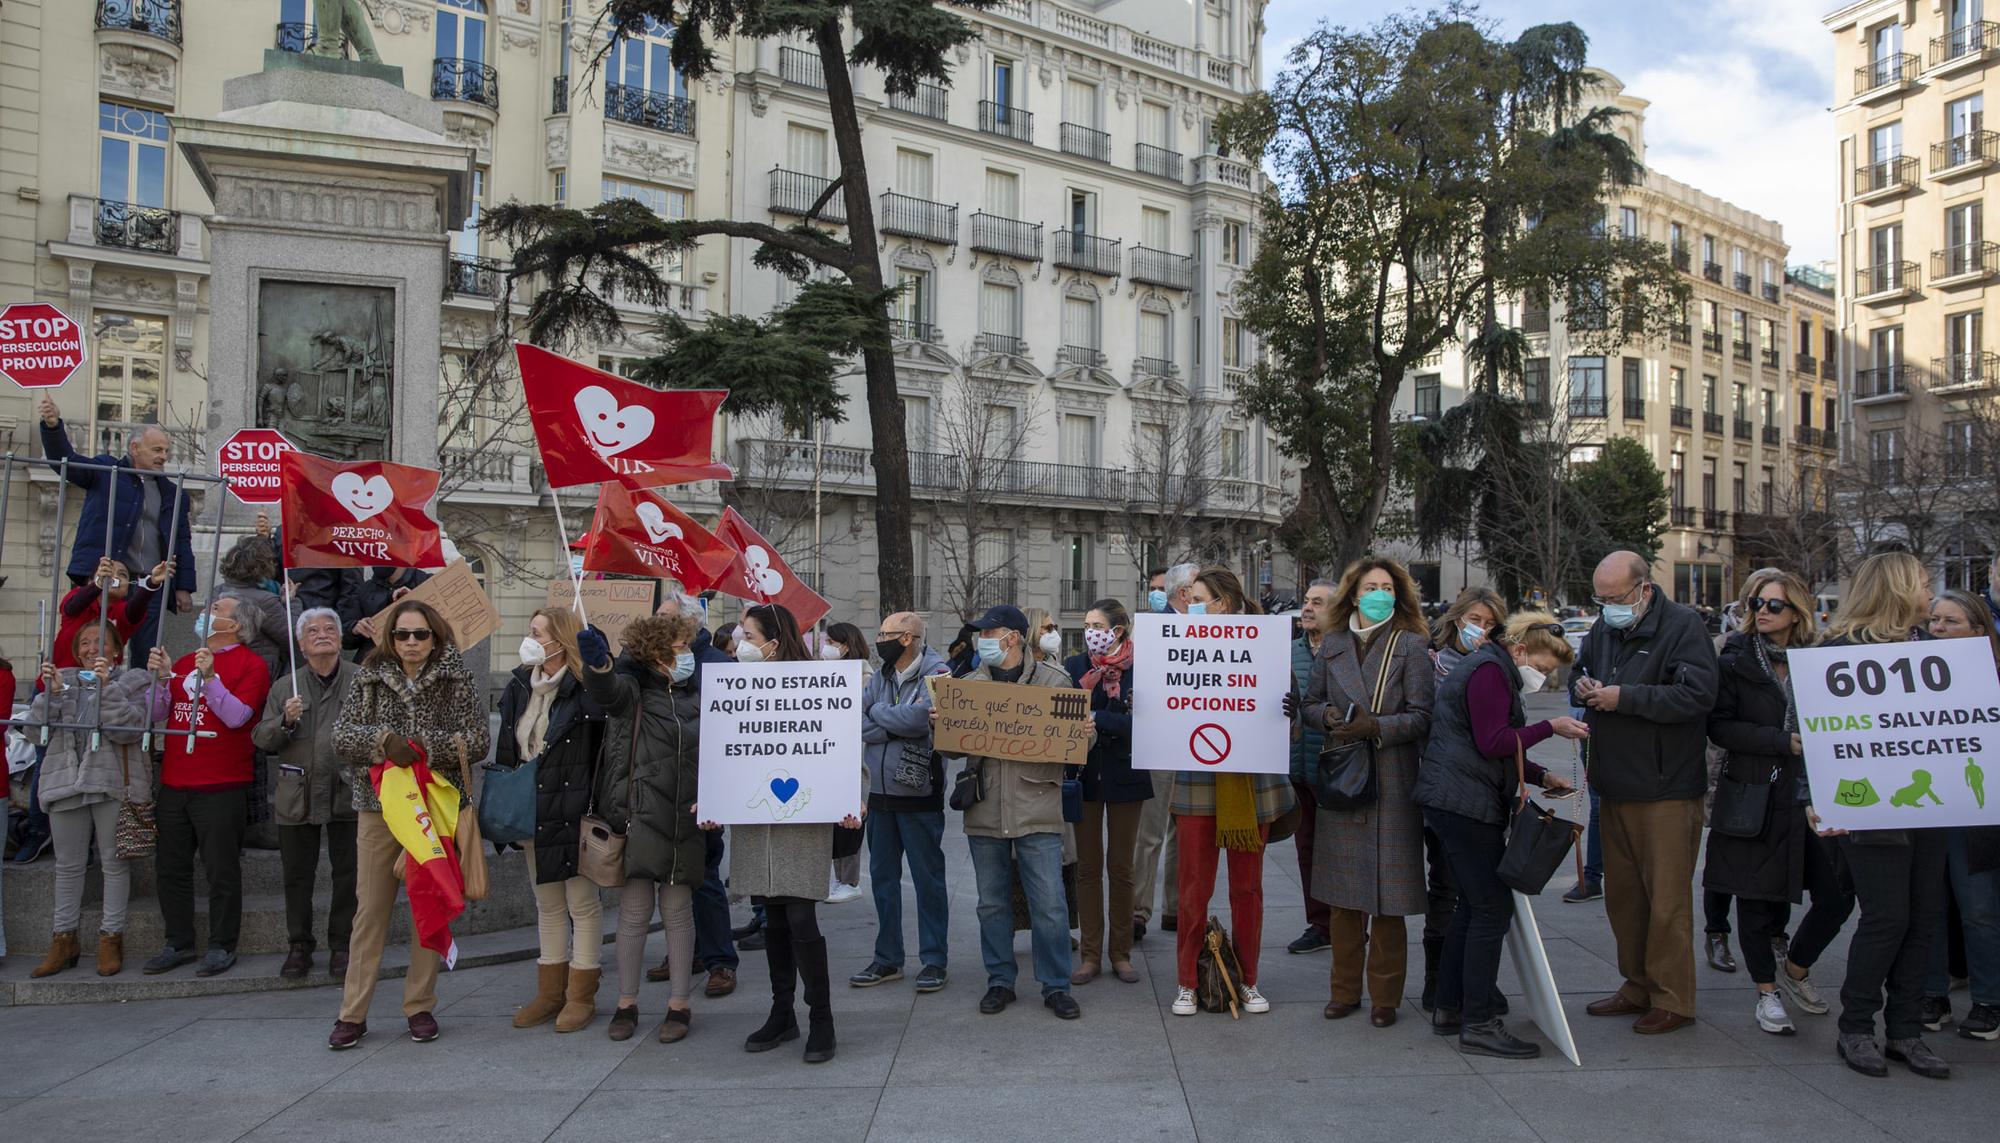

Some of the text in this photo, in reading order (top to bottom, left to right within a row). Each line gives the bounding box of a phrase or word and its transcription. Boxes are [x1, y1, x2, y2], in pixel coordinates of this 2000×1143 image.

[0, 317, 69, 340] STOP
[0, 339, 79, 353] ERSECUCIÓN
[2, 355, 75, 370] PROVIDA
[227, 442, 290, 460] STOP
[228, 476, 281, 488] PROVID
[332, 526, 392, 540] DERECHO A
[332, 540, 392, 560] VIVIR
[634, 549, 683, 574] VIVIR
[1162, 624, 1259, 639] EL ABORTO
[1168, 648, 1252, 665] DEJA A LA
[717, 672, 847, 690] "YO NO ESTARÍA
[1166, 673, 1257, 690] MUJER SIN
[1825, 655, 1952, 698] 6010
[709, 696, 853, 714] AQUÍ SI ELLOS NO
[940, 684, 1043, 717] ¿Por qué nos
[1167, 696, 1256, 712] OPCIONES
[174, 711, 204, 726] VIVR
[739, 720, 823, 734] HUBIERAN
[942, 715, 1085, 740] queréis meter en la
[1804, 707, 2000, 733] VIDAS SALVADAS
[725, 738, 836, 756] ESTADO ALLÍ"
[1833, 737, 1982, 760] EN RESCATES
